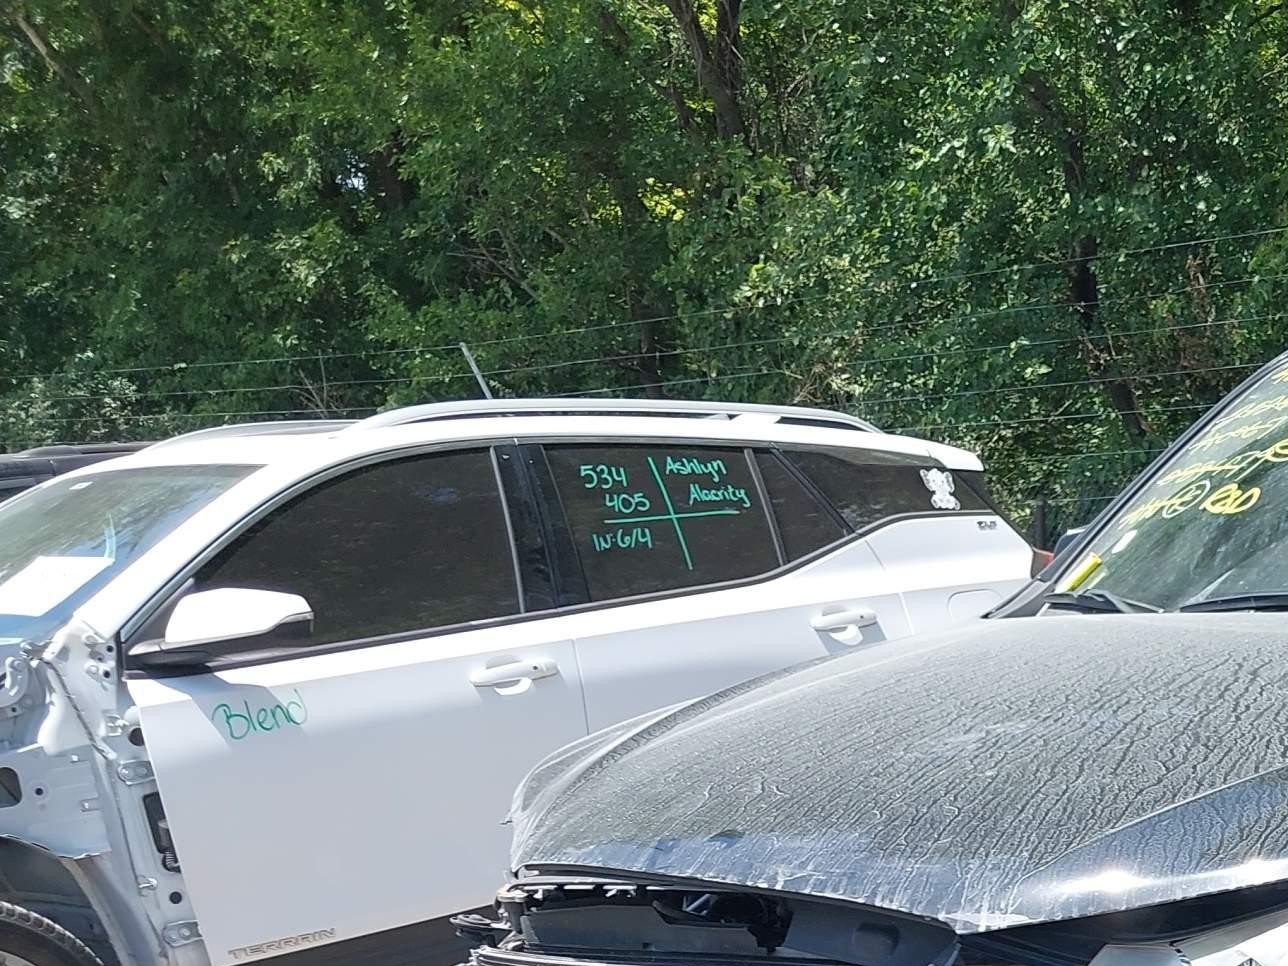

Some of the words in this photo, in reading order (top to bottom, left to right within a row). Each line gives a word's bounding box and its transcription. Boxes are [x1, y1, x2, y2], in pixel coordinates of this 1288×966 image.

[580, 464, 628, 489] 534
[665, 455, 727, 483] Ashlyn
[605, 492, 651, 514] 405
[688, 483, 751, 508] Alacrity
[211, 688, 308, 740] Blend
[227, 927, 336, 960] TERRAIN
